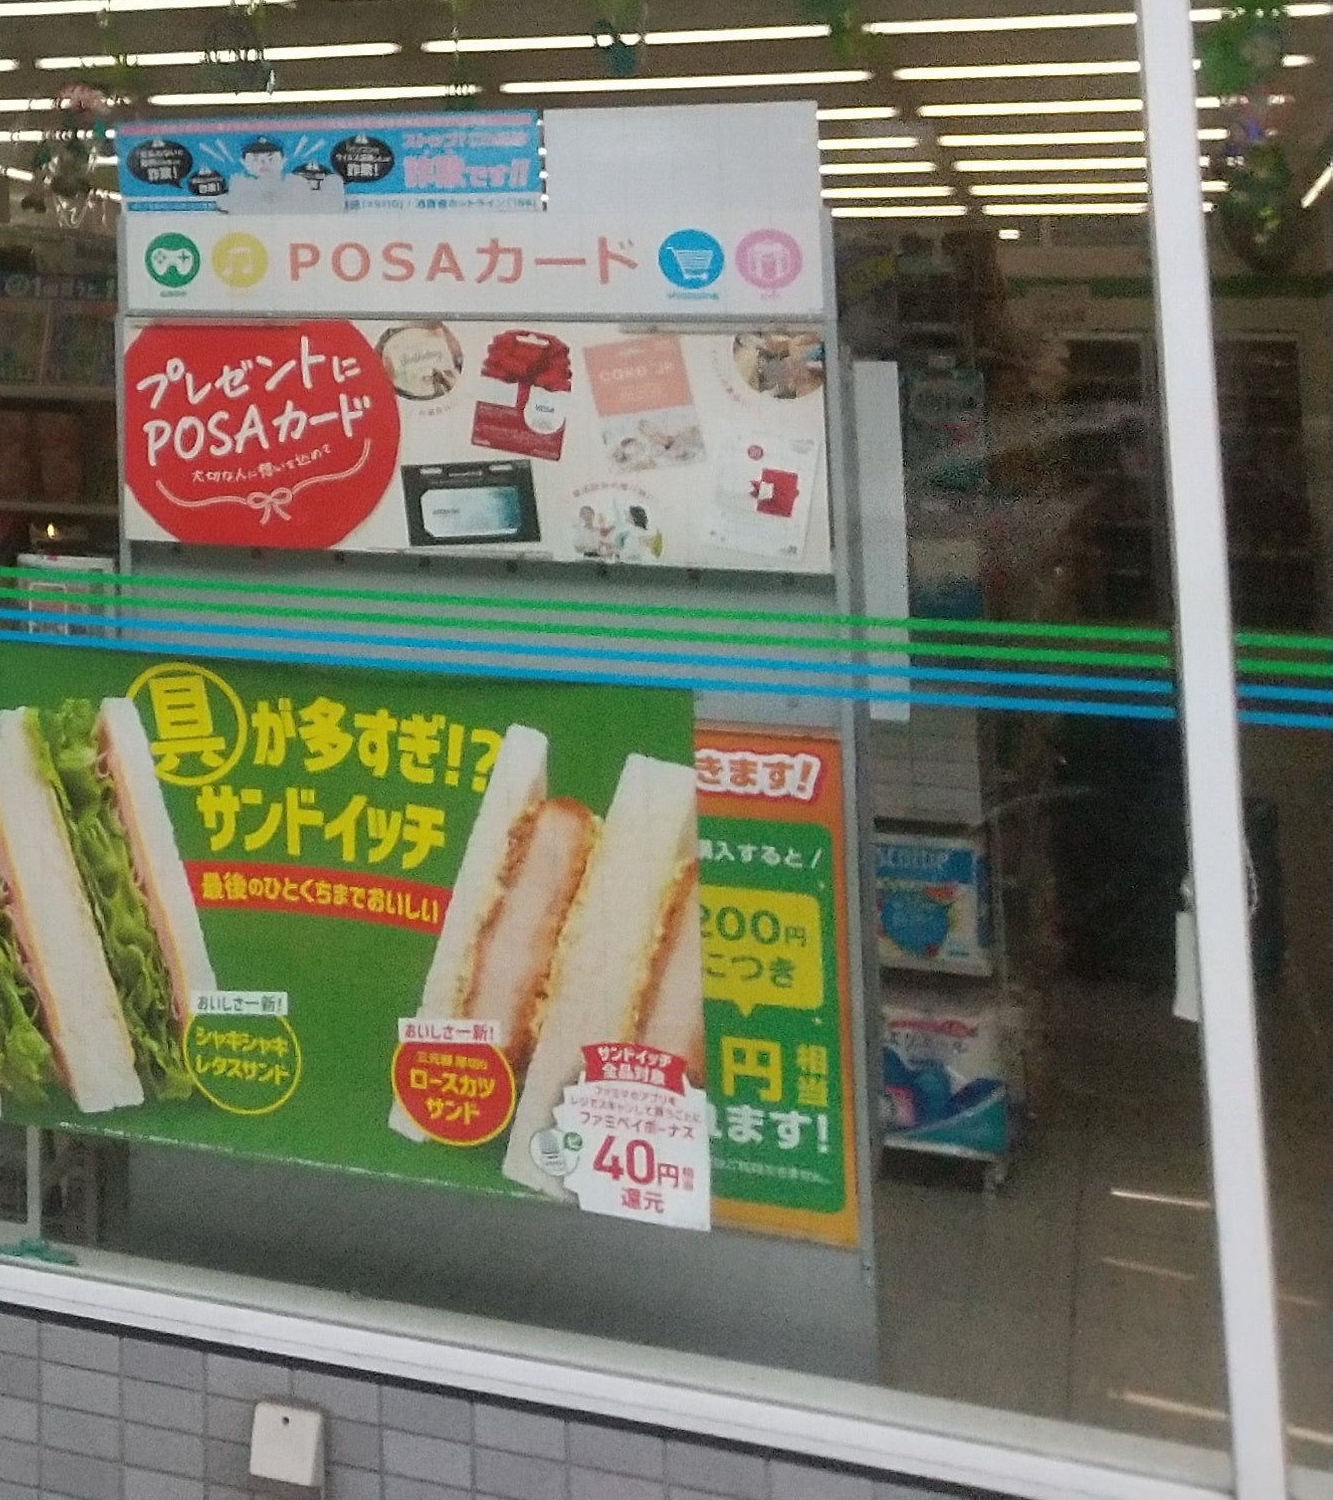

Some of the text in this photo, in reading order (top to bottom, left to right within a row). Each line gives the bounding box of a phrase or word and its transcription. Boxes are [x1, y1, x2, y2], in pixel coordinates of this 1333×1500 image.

[289, 236, 639, 285] POSAカード
[136, 335, 361, 409] プレゼントに
[143, 393, 371, 466] POSAカード
[195, 785, 445, 870] サンドイッチ
[201, 871, 440, 924] 最後のひとくちまでおいしい
[195, 1027, 289, 1057] シャキシャキ
[597, 1046, 672, 1068] サンドイッチ
[194, 1054, 290, 1085] レタスサンド
[409, 1068, 496, 1098] ロースカツ
[721, 1036, 782, 1102] 円
[426, 1098, 480, 1125] サンド
[581, 1112, 694, 1139] ファミペイボーナス
[593, 1135, 680, 1189] 40円
[621, 1187, 664, 1213] 還元
